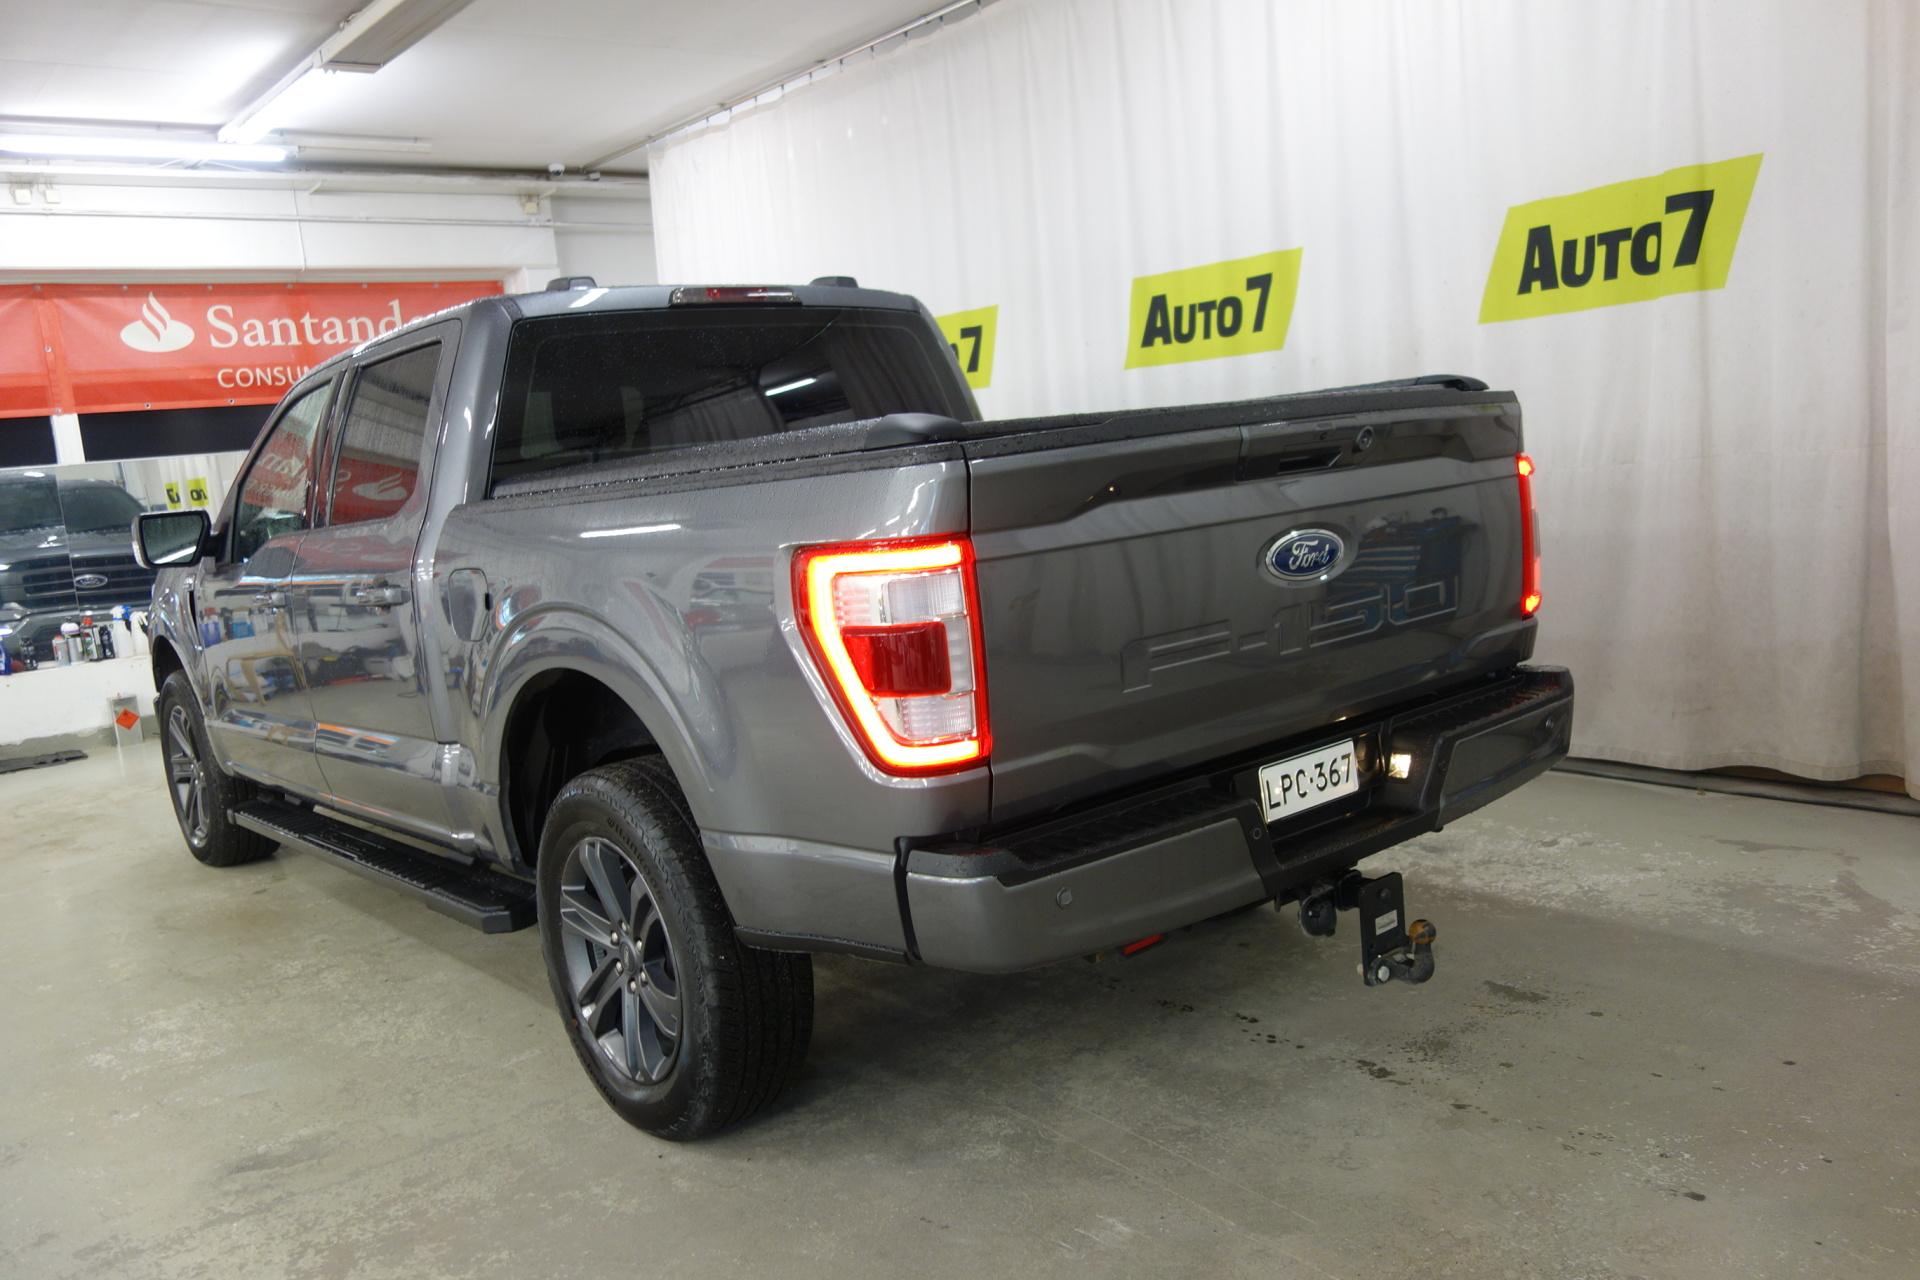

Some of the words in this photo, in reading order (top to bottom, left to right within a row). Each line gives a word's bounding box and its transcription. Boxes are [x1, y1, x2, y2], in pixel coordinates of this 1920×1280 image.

[206, 299, 423, 348] Santand
[1289, 540, 1330, 570] Ford
[1121, 576, 1460, 693] F-150
